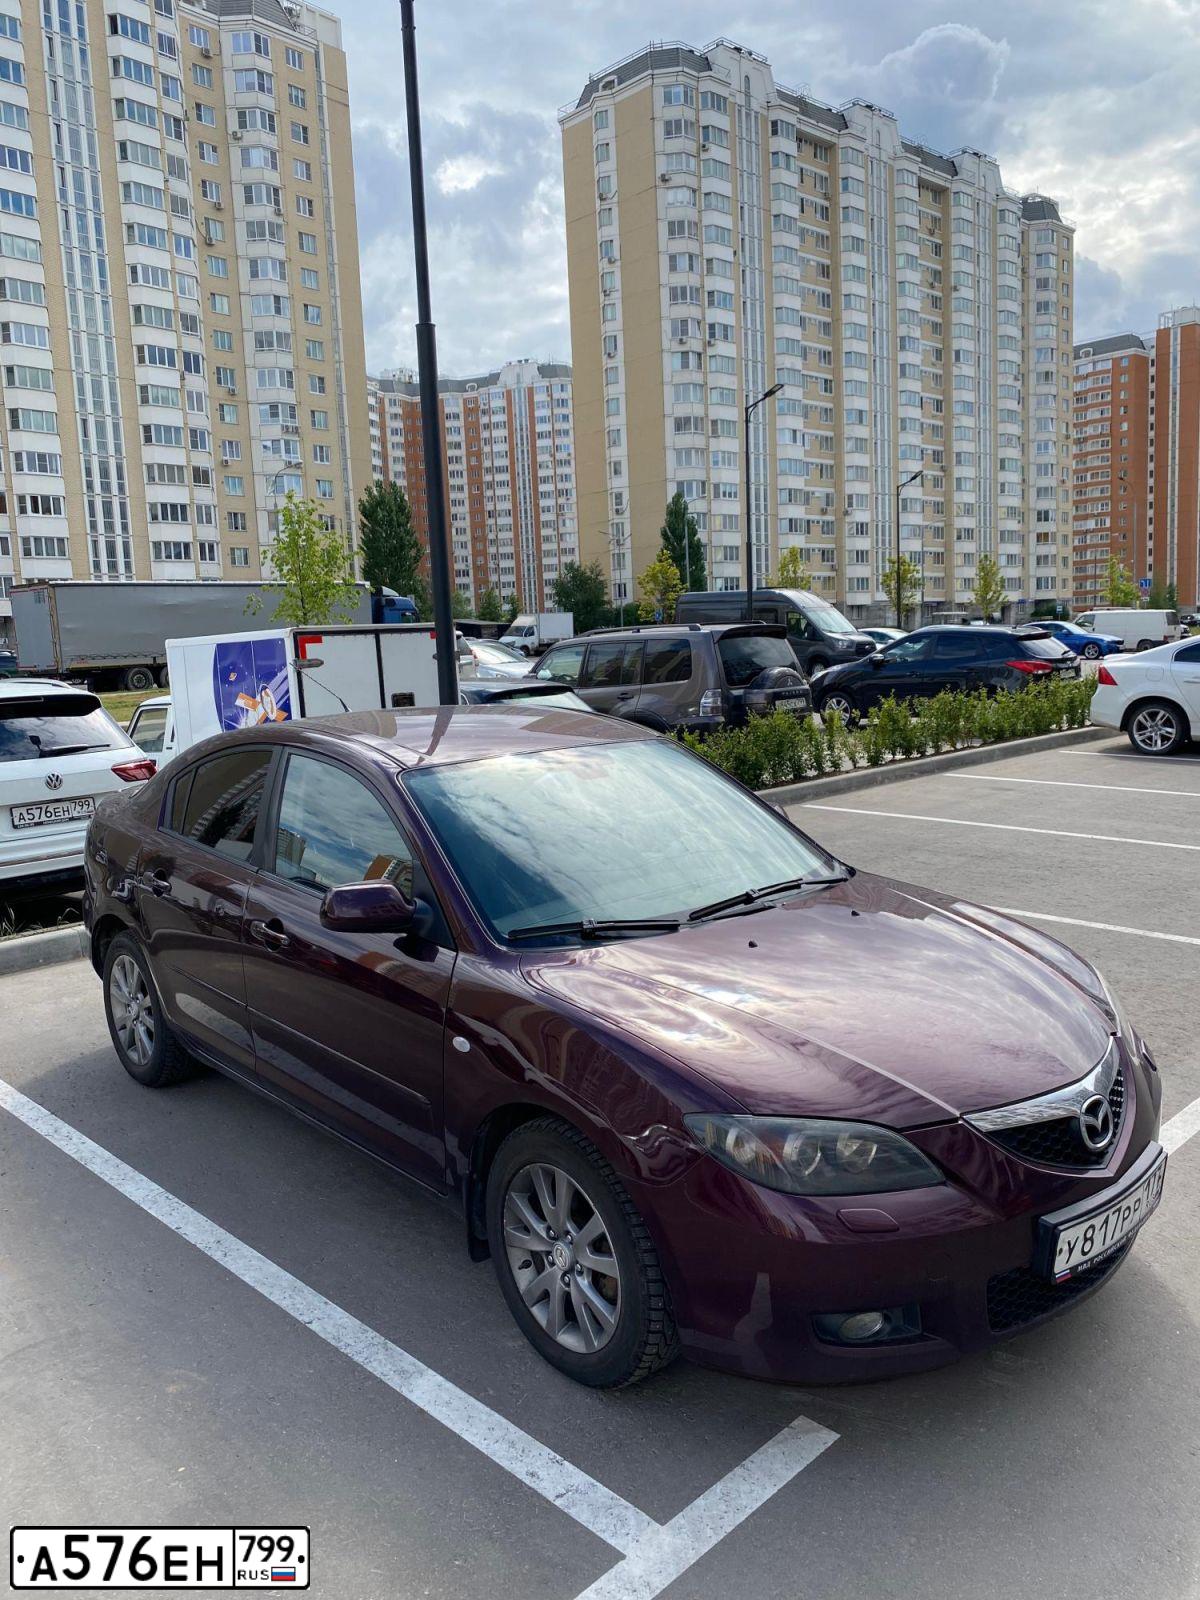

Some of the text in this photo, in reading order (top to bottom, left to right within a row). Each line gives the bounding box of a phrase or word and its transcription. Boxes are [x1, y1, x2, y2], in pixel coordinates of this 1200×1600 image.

[18, 805, 71, 823] А576ЕН
[71, 799, 91, 811] 799
[1065, 1197, 1141, 1264] У817РР
